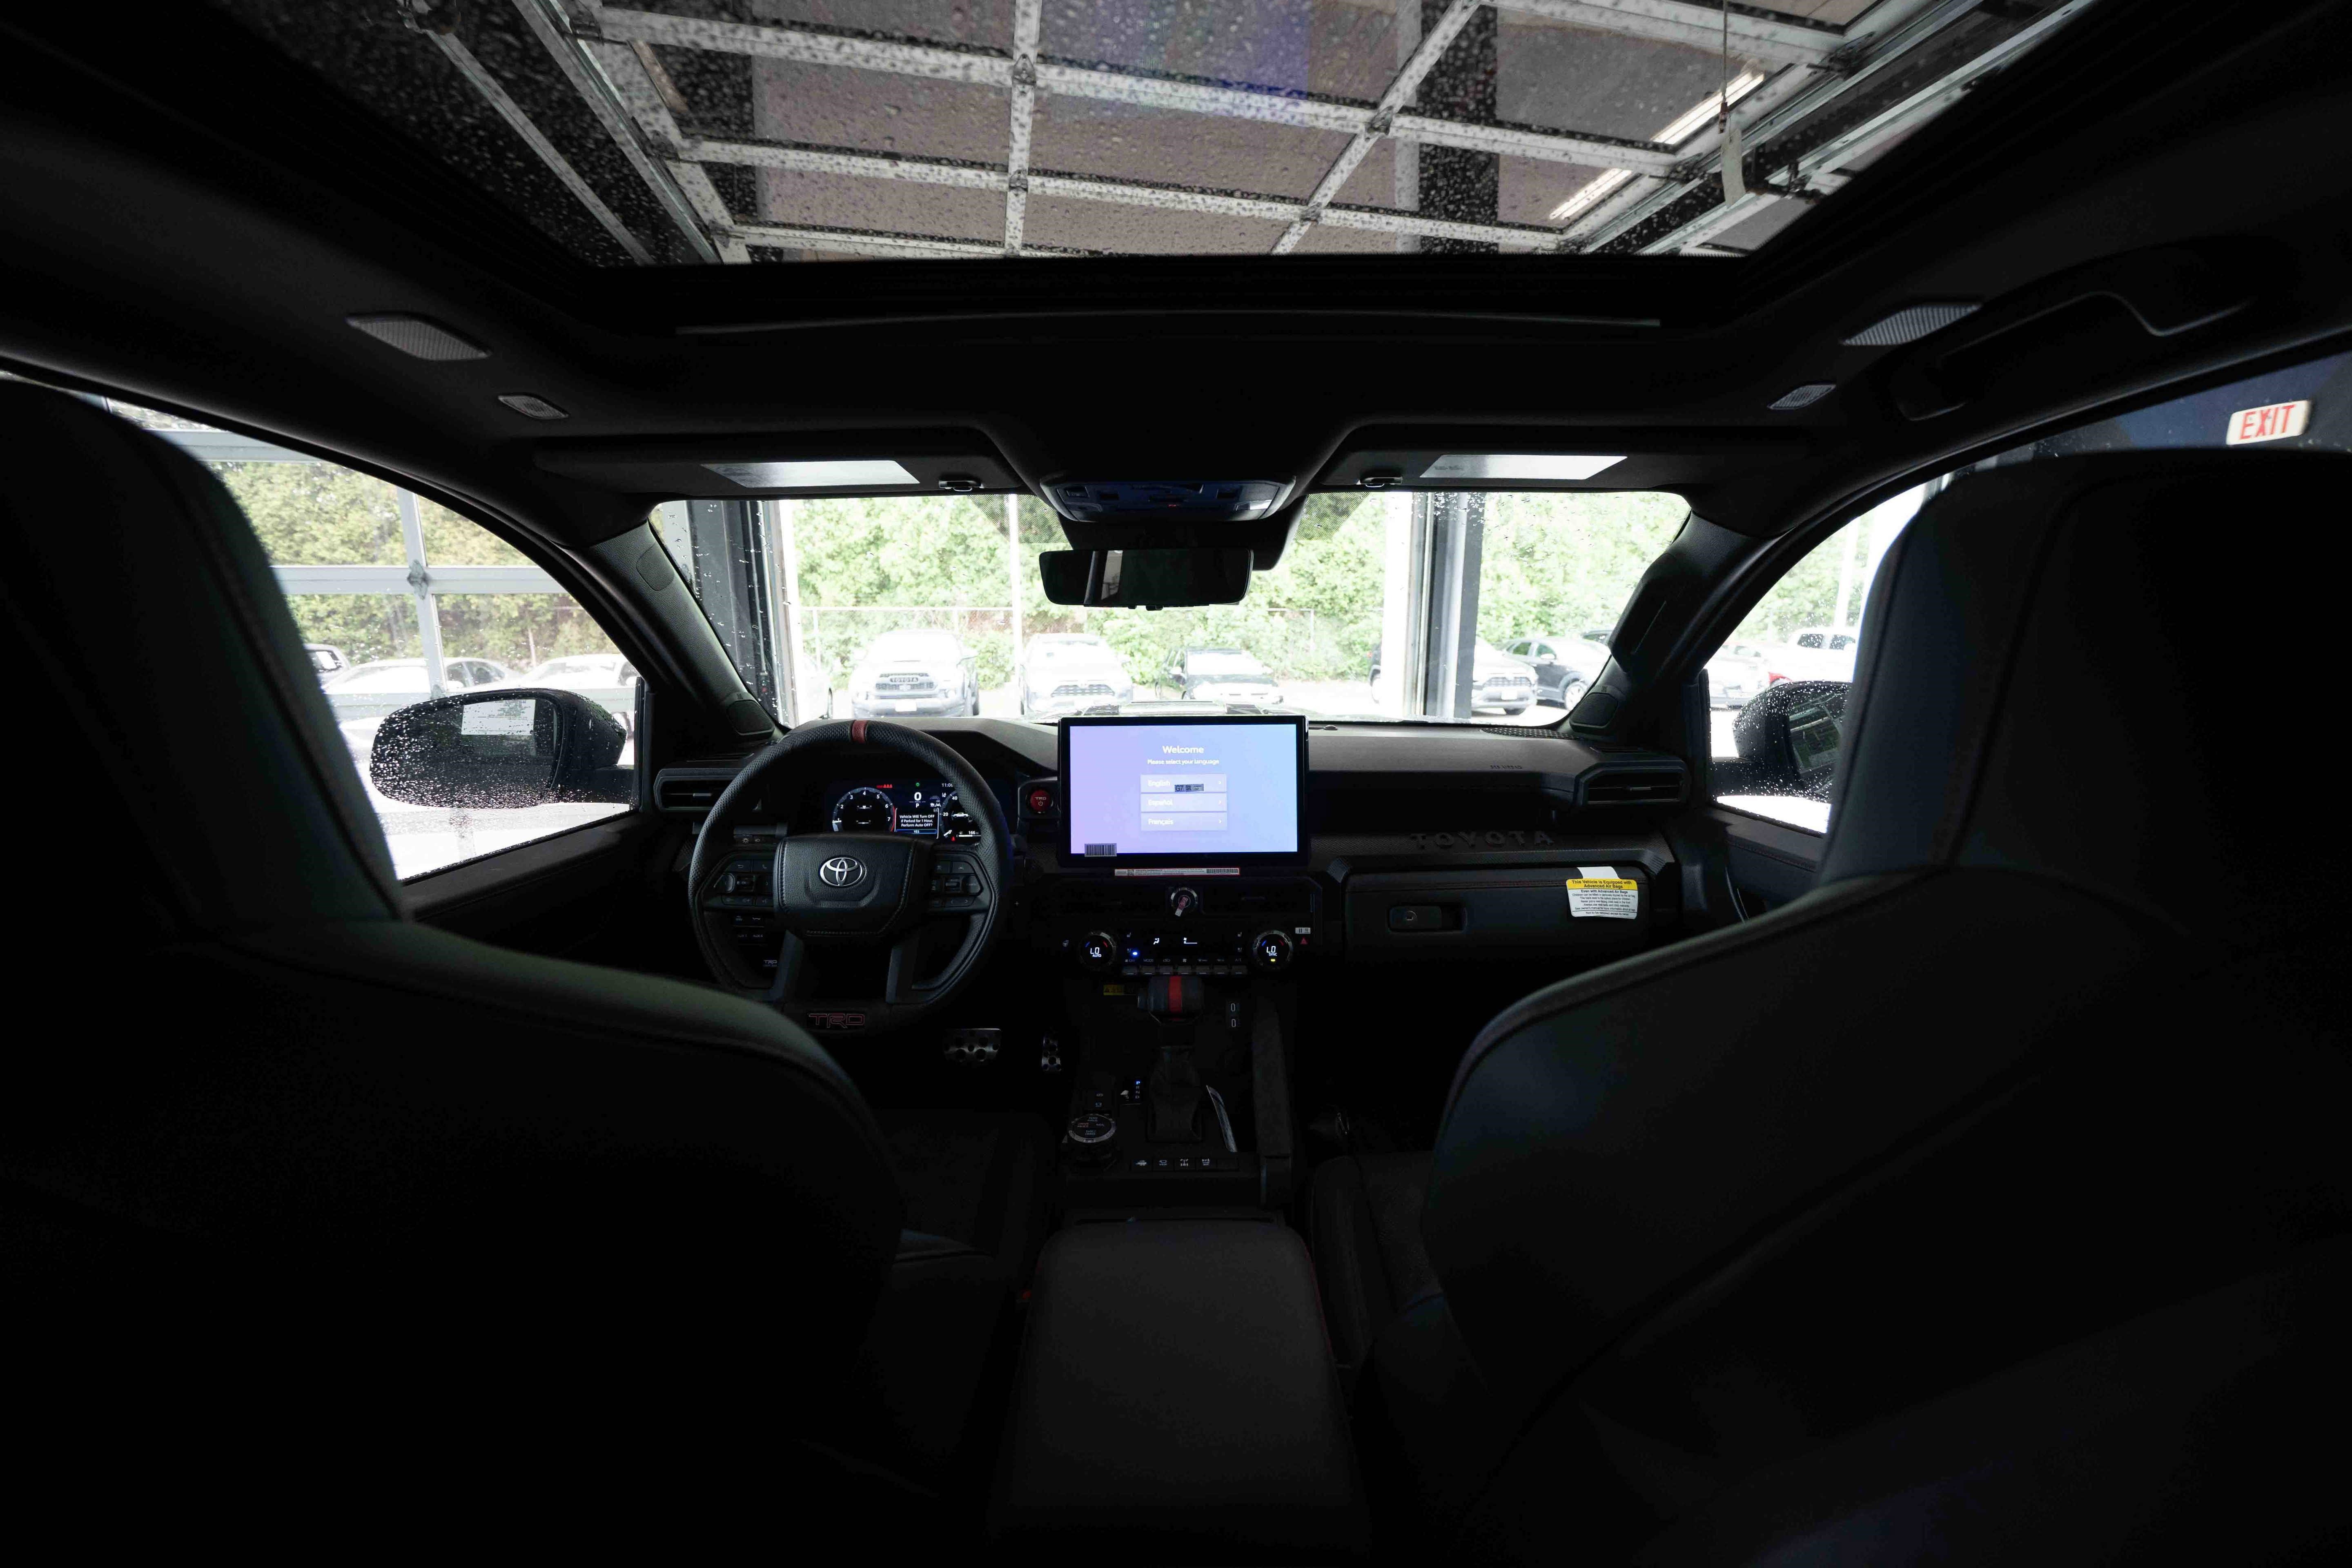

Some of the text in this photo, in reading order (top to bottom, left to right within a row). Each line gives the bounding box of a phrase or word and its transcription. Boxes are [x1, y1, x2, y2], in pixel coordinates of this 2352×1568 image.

[2239, 405, 2296, 440] EXIT
[914, 792, 922, 801] 0
[1148, 798, 1173, 807] Español
[1410, 830, 1555, 849] TOYOTA
[808, 1013, 865, 1029] TRD
